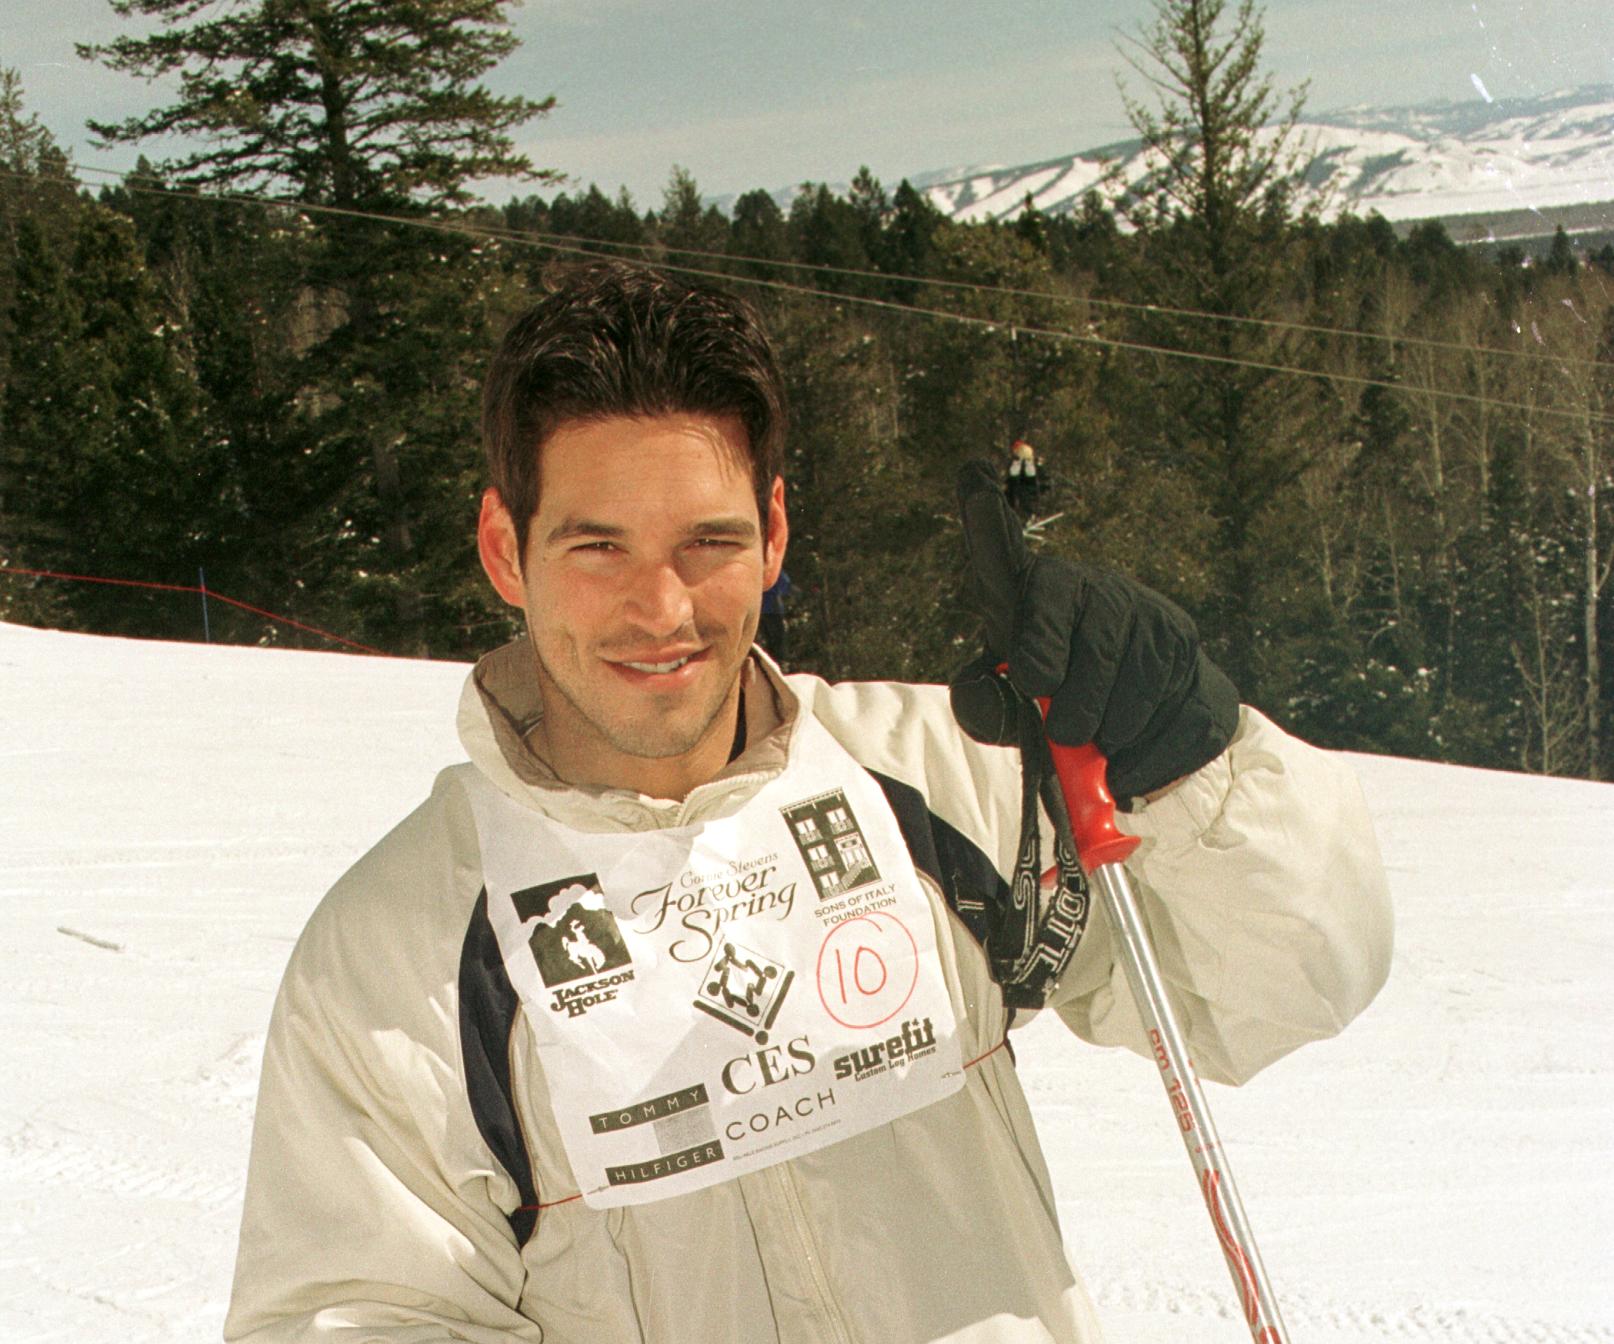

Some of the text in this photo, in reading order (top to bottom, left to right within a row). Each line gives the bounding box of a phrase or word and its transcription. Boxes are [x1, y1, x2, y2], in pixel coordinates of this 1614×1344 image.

[727, 852, 778, 876] Stevens
[631, 866, 777, 934] Forever
[814, 883, 897, 918] SONS OF ITALY
[823, 896, 897, 927] FOUNDATION
[669, 882, 797, 962] Spring
[550, 969, 636, 1012] JACKSON
[835, 945, 887, 1004] 10
[565, 990, 618, 1018] HOLE
[721, 1034, 816, 1096] CES
[833, 1017, 937, 1080] surefit
[854, 1046, 937, 1082] Custom Log Homes
[598, 1089, 699, 1129] TOMMY
[725, 1087, 836, 1141] COACH
[615, 1147, 717, 1181] HILFIGER
